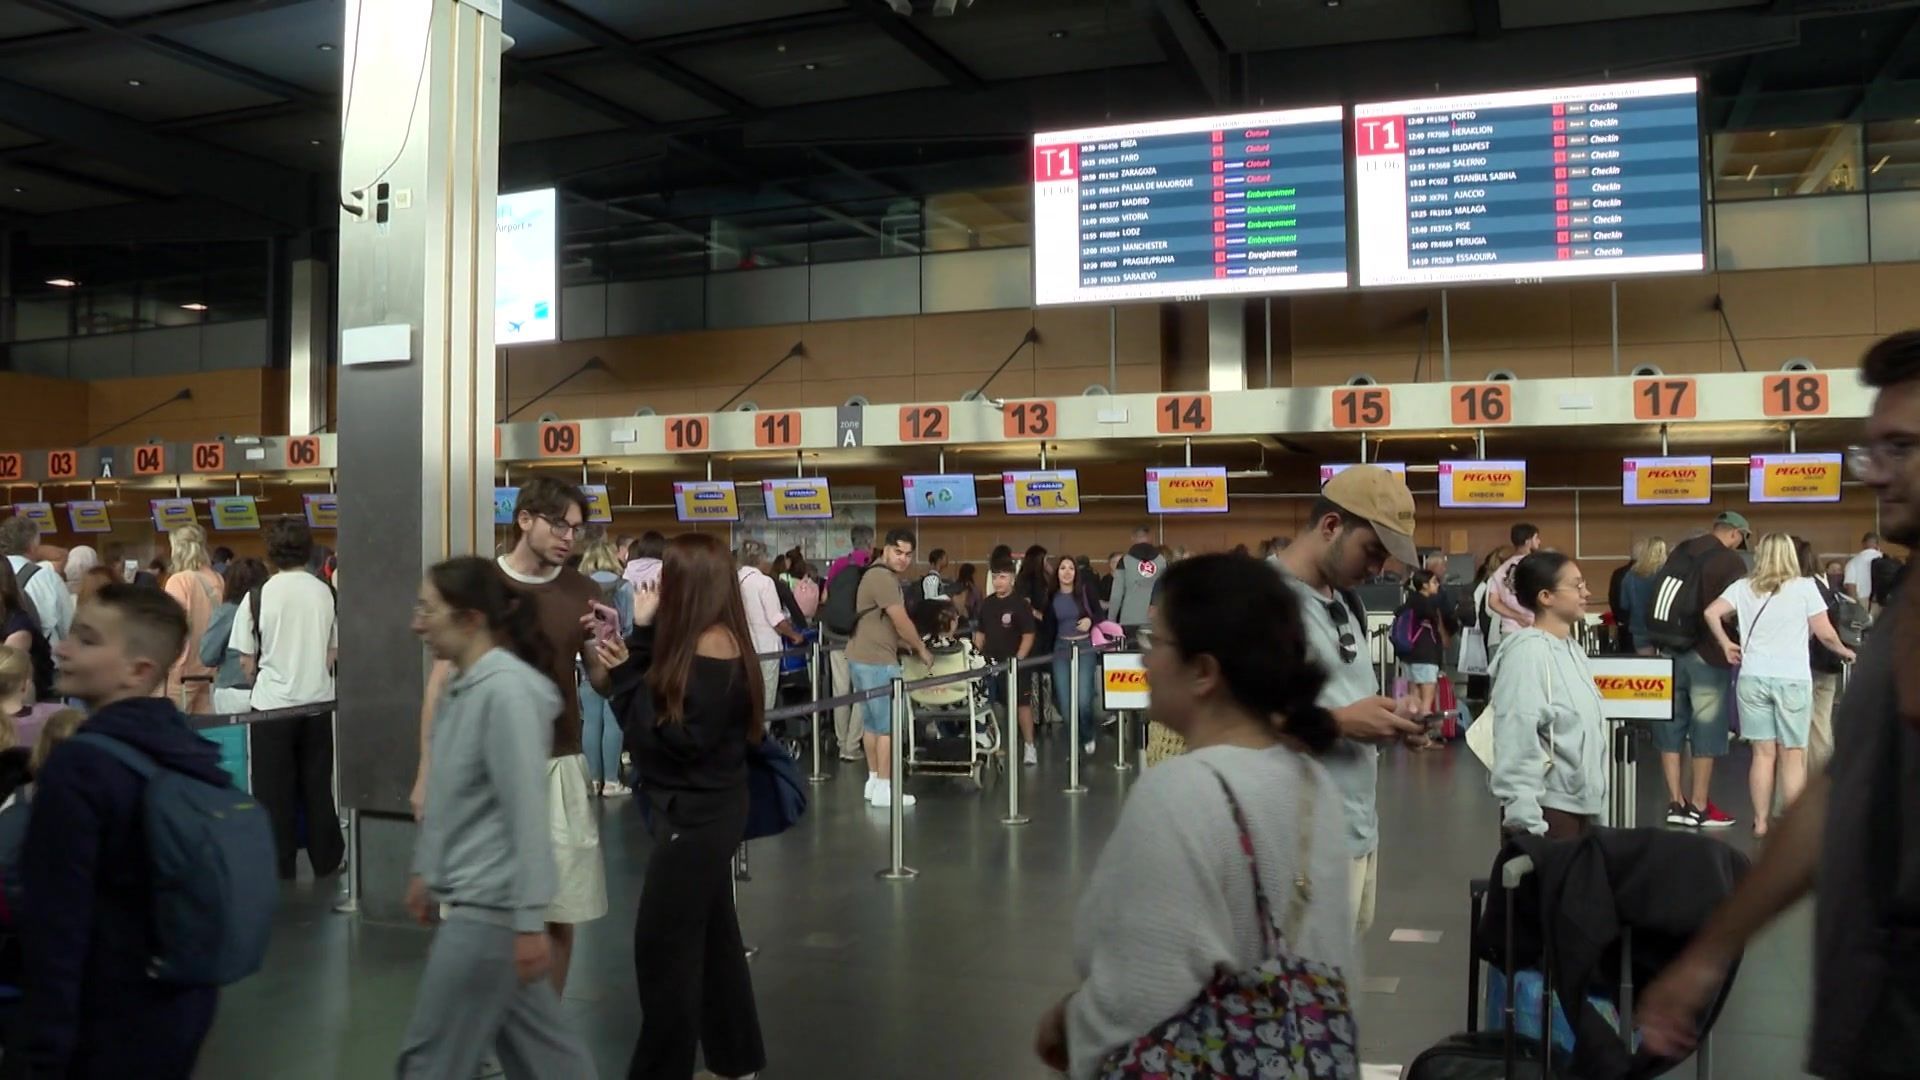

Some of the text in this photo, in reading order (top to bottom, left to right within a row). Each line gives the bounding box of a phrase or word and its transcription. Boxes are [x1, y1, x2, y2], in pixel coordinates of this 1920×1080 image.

[1451, 112, 1476, 120] PORTO
[1362, 120, 1399, 150] T1
[1452, 126, 1493, 136] HERAKLION
[1452, 142, 1490, 152] BUDAPEST
[1040, 148, 1074, 176] T1
[1121, 153, 1139, 162] FARO
[1453, 158, 1486, 167] SALERNO
[1121, 168, 1157, 177] ZARAGOZA
[1454, 173, 1488, 183] ISTANBUL
[1489, 171, 1516, 181] SABIHA
[1121, 183, 1144, 192] PALMA
[1156, 178, 1193, 189] MAJORQUE
[1454, 188, 1485, 199] AJACCIO
[1122, 197, 1150, 206] MADRID
[1246, 188, 1296, 200] Embarquement
[1122, 212, 1149, 222] VITORIA
[1247, 203, 1296, 215] Embarquement
[1454, 204, 1486, 214] MALAGA
[1122, 228, 1140, 237] LODZ
[1247, 219, 1296, 230] Embarquement
[1455, 221, 1471, 230] PISE
[1122, 241, 1168, 251] MANCHESTER
[1248, 234, 1297, 246] Embarquement
[1456, 236, 1487, 246] PERUGIA
[1123, 255, 1175, 266] PRAGUE/PRAHA
[1248, 248, 1297, 260] Enregistrement
[1456, 252, 1497, 262] ESSAOUIRA
[1123, 271, 1157, 281] SARAJEVO
[1248, 264, 1298, 276] Enregistrement
[1643, 381, 1688, 416] 17
[1773, 377, 1821, 412] 18
[1340, 391, 1384, 424] 15
[1460, 387, 1504, 421] 16
[1011, 404, 1049, 434] 13
[1165, 398, 1205, 430] 14
[762, 415, 791, 443] 11
[906, 408, 942, 438] 12
[544, 426, 574, 453] 09
[670, 420, 703, 448] 10
[843, 430, 857, 447] A
[137, 449, 160, 471] 04
[196, 445, 219, 469] 05
[289, 440, 315, 465] 06
[51, 453, 71, 475] 03
[102, 464, 111, 478] A
[1775, 466, 1826, 475] PEGASUS
[1648, 469, 1697, 478] PEGASUS
[1594, 679, 1665, 690] PEGASUS
